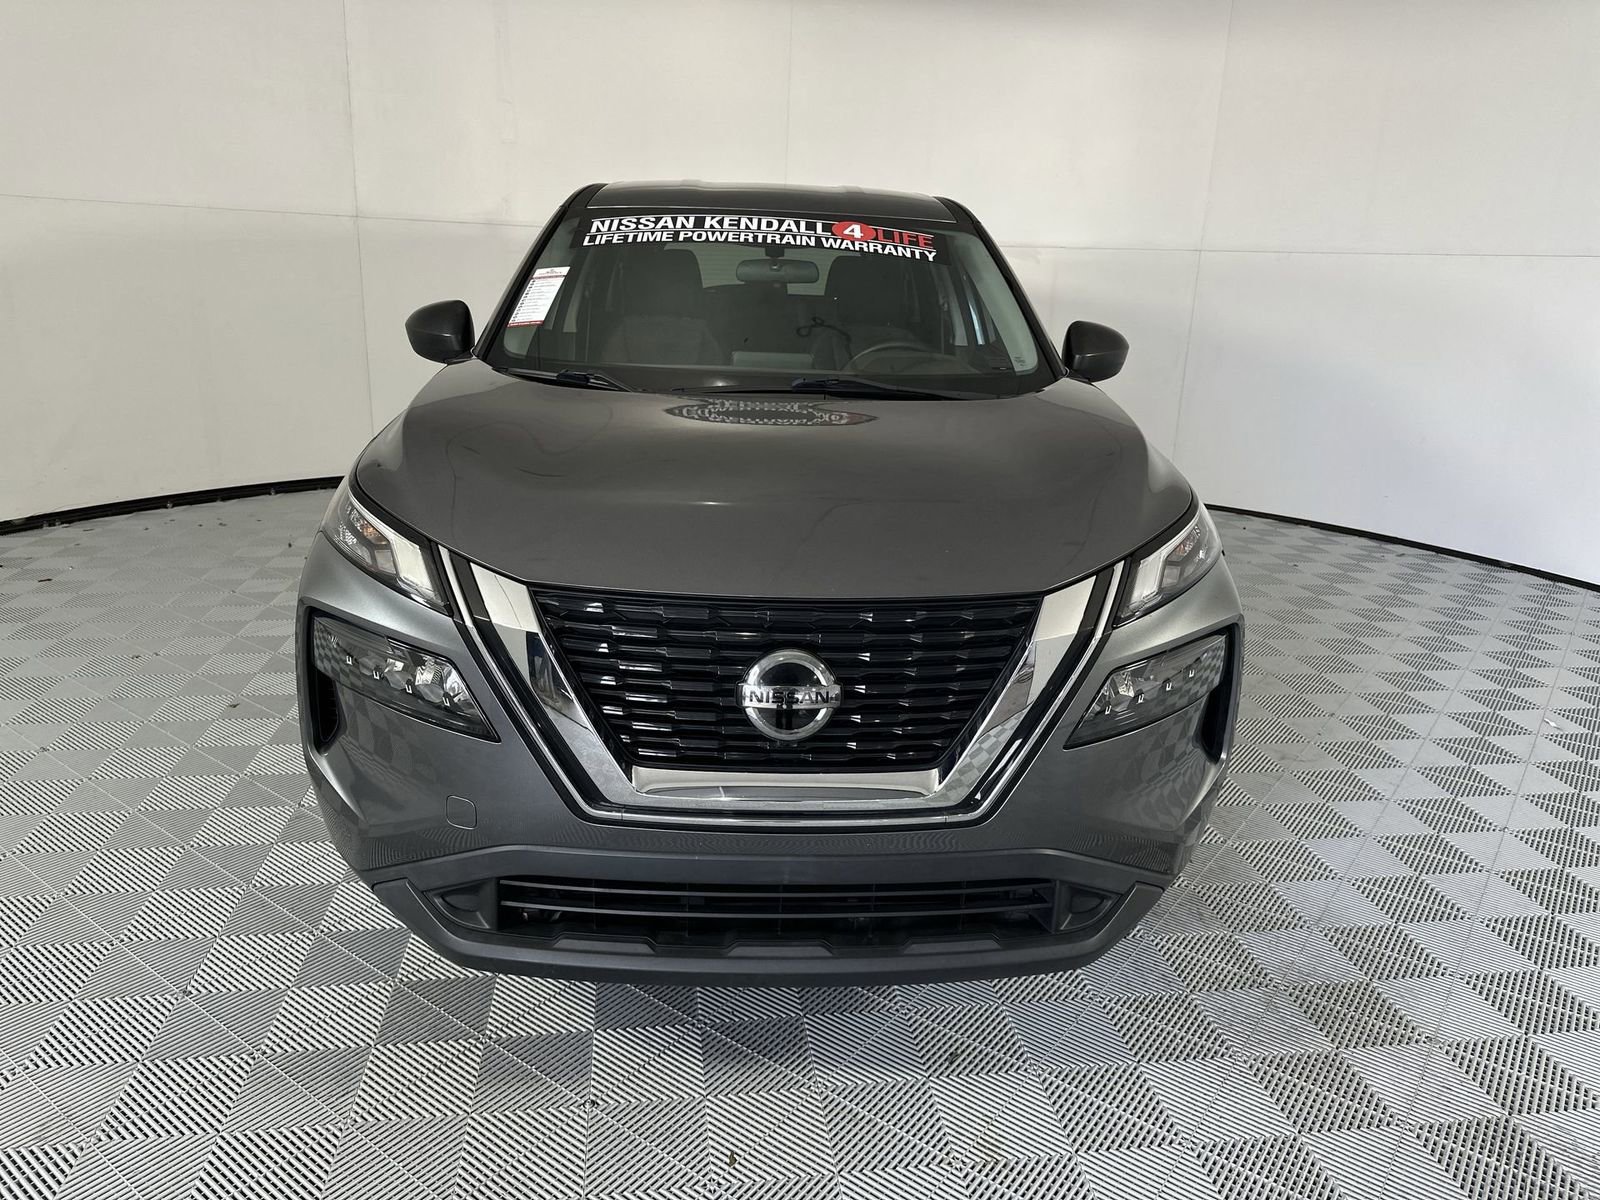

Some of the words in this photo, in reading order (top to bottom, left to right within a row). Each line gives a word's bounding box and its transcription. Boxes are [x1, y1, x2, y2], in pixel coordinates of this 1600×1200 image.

[583, 231, 674, 246] LIFETIME
[679, 231, 816, 247] POWERTRAIN
[820, 237, 937, 262] WARRANTY
[590, 216, 695, 234] NISSAN
[704, 216, 832, 236] KENDALL
[843, 223, 863, 239] 4
[877, 228, 934, 249] LIFE
[749, 690, 829, 704] NISSAN
